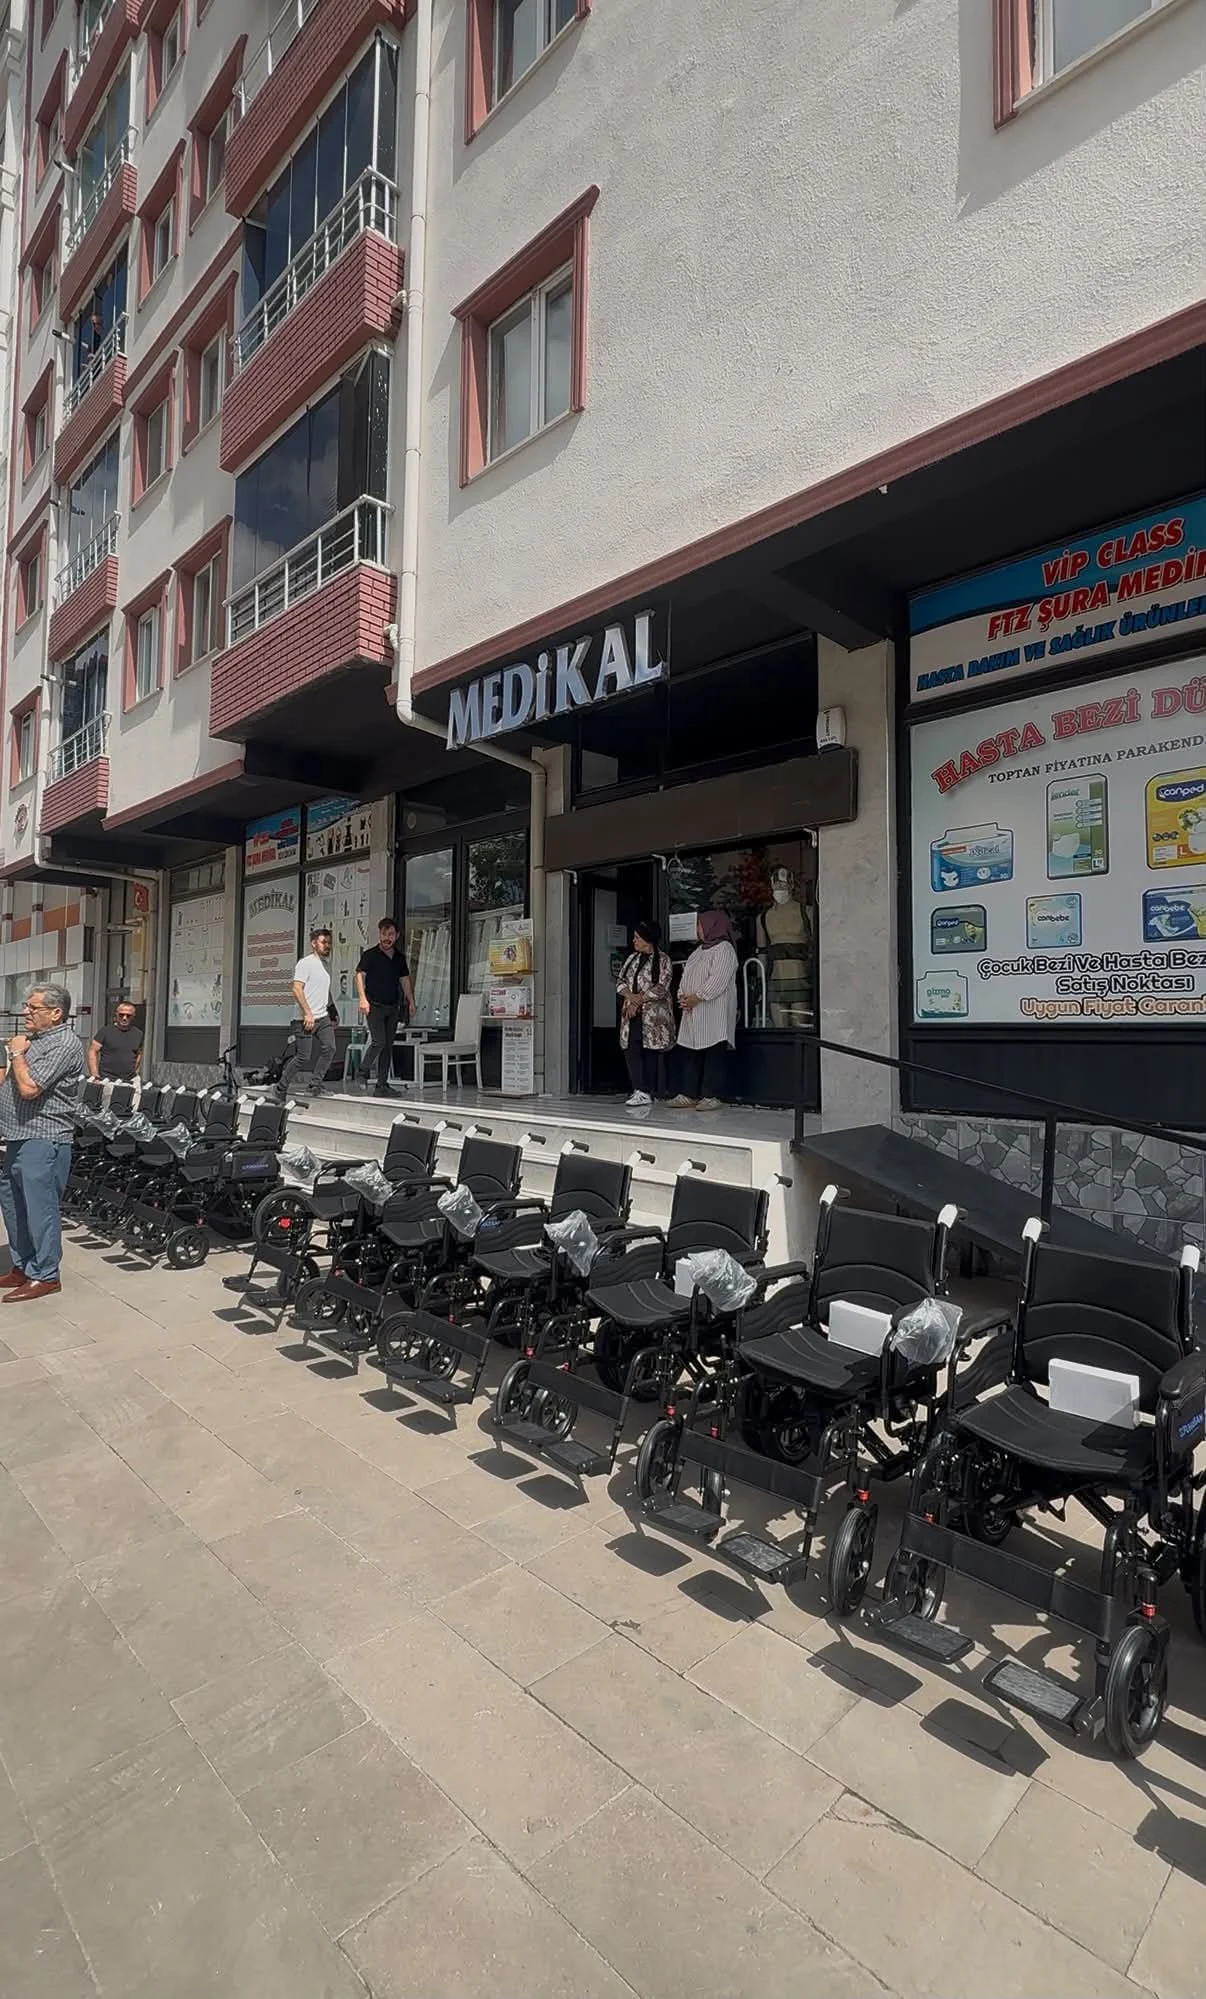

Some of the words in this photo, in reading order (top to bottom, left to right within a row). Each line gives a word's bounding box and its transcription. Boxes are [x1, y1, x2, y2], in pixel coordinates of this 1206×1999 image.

[1042, 549, 1089, 587] VİP
[1096, 518, 1185, 568] CLASS
[987, 604, 1033, 641] FTZ
[1037, 581, 1110, 633] ŞURA
[931, 722, 1046, 793] HASTA
[1052, 688, 1141, 740] BEZİ
[988, 766, 1040, 784] TOPTAN
[1045, 751, 1112, 774] FİYATINA
[1116, 734, 1206, 762] PARAKEND
[979, 957, 1033, 978] Çocuk
[1036, 954, 1073, 973] Bezi
[1077, 955, 1101, 971] Ve
[1105, 950, 1167, 970] Hasta
[1058, 976, 1108, 996] Satış
[1113, 973, 1193, 992] Noktası
[1022, 1000, 1081, 1018] Uygun
